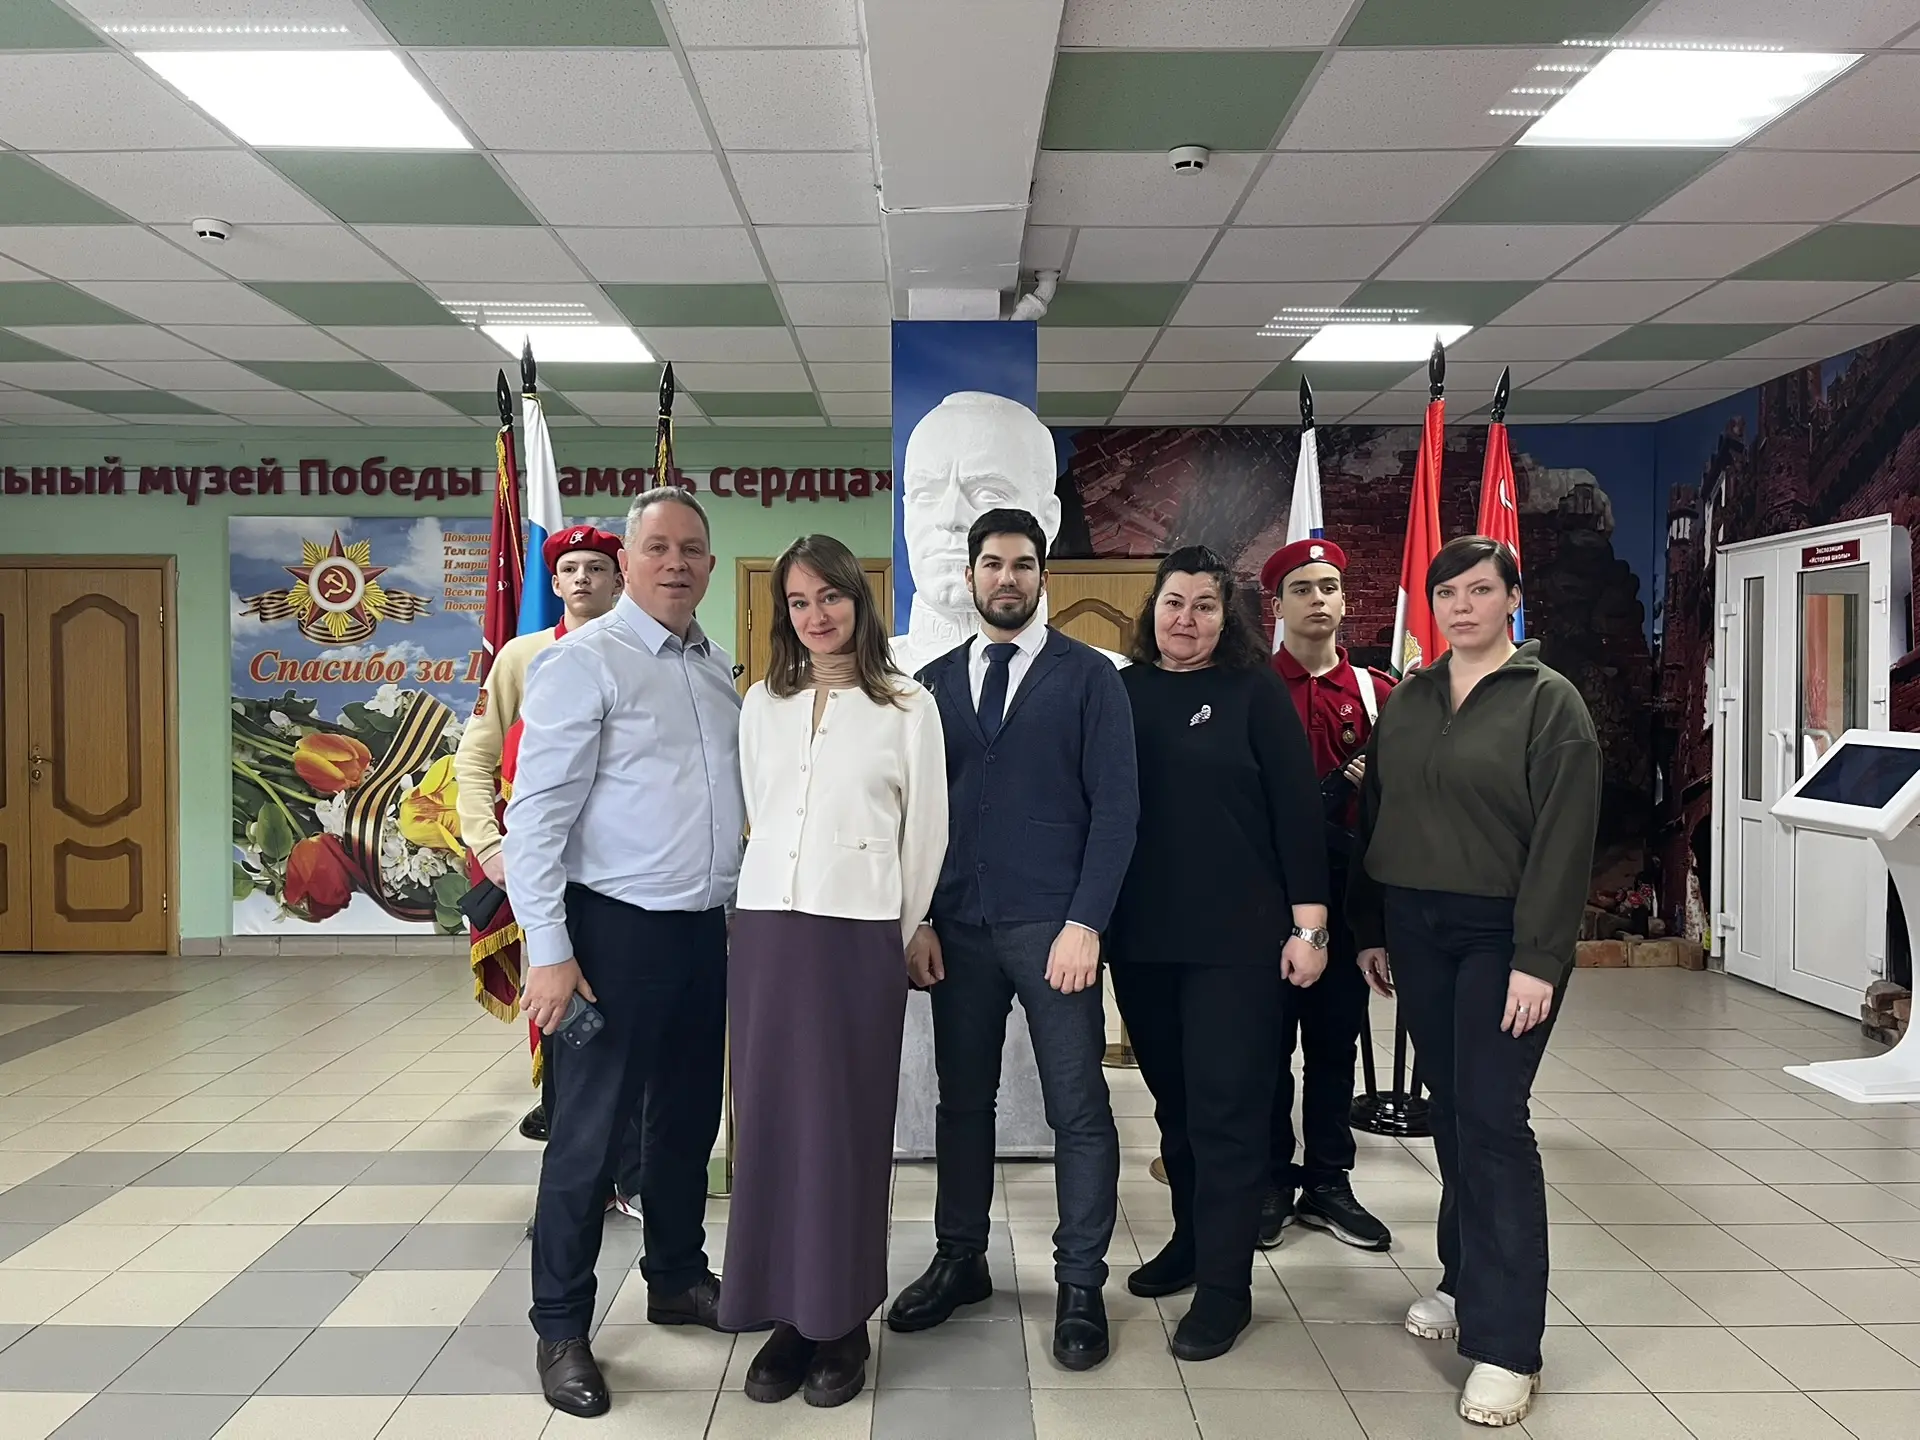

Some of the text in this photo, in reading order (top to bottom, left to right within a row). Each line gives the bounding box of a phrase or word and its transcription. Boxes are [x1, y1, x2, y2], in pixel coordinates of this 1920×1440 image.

[0, 456, 124, 496] ьный
[138, 457, 284, 506] музей
[299, 456, 483, 501] Победы
[443, 532, 491, 543] Поклони
[444, 545, 490, 556] Тем сла
[444, 559, 487, 572] И марш
[444, 573, 488, 583] Поклон
[445, 587, 472, 597] Всем
[445, 601, 485, 610] Поклон
[250, 649, 407, 684] Спасибо
[415, 659, 456, 684] за
